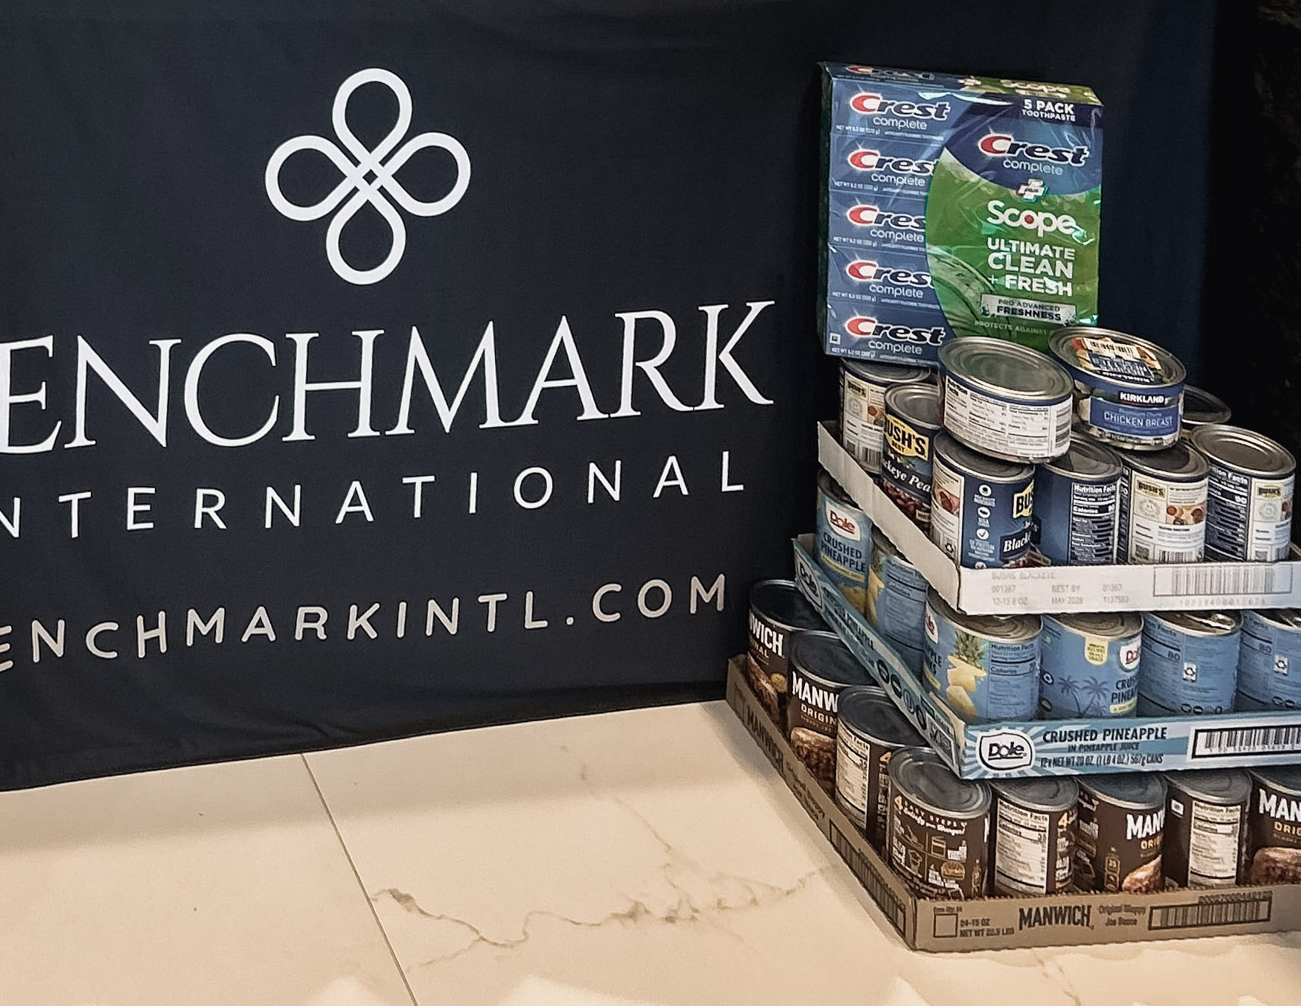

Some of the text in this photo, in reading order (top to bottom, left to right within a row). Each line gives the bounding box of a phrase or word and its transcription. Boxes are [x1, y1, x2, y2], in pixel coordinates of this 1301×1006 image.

[850, 93, 950, 120] Crest
[1024, 100, 1074, 115] 5 PACK
[873, 117, 927, 130] complete
[1022, 109, 1076, 122] TOOTHPASTE
[978, 134, 1089, 167] Crest
[1003, 159, 1063, 176] complete
[871, 173, 926, 186] complete
[987, 201, 1076, 237] Scope
[987, 237, 1075, 260] ULTIMATE
[988, 253, 1074, 278] CLEAN
[869, 284, 924, 298] complete
[1005, 276, 1073, 297] FRESH
[996, 306, 1061, 321] FRESHNESS
[846, 316, 945, 346] Crest
[868, 341, 922, 355] complete
[1120, 392, 1165, 404] KIRKLAND
[1104, 411, 1173, 427] CHICKEN BREAST
[830, 509, 856, 532] Dole
[823, 532, 862, 560] CRUSHED
[1042, 726, 1167, 743] CRUSHED PINEAPPLE
[988, 742, 1025, 760] Dole
[1018, 904, 1092, 930] MANWICH
